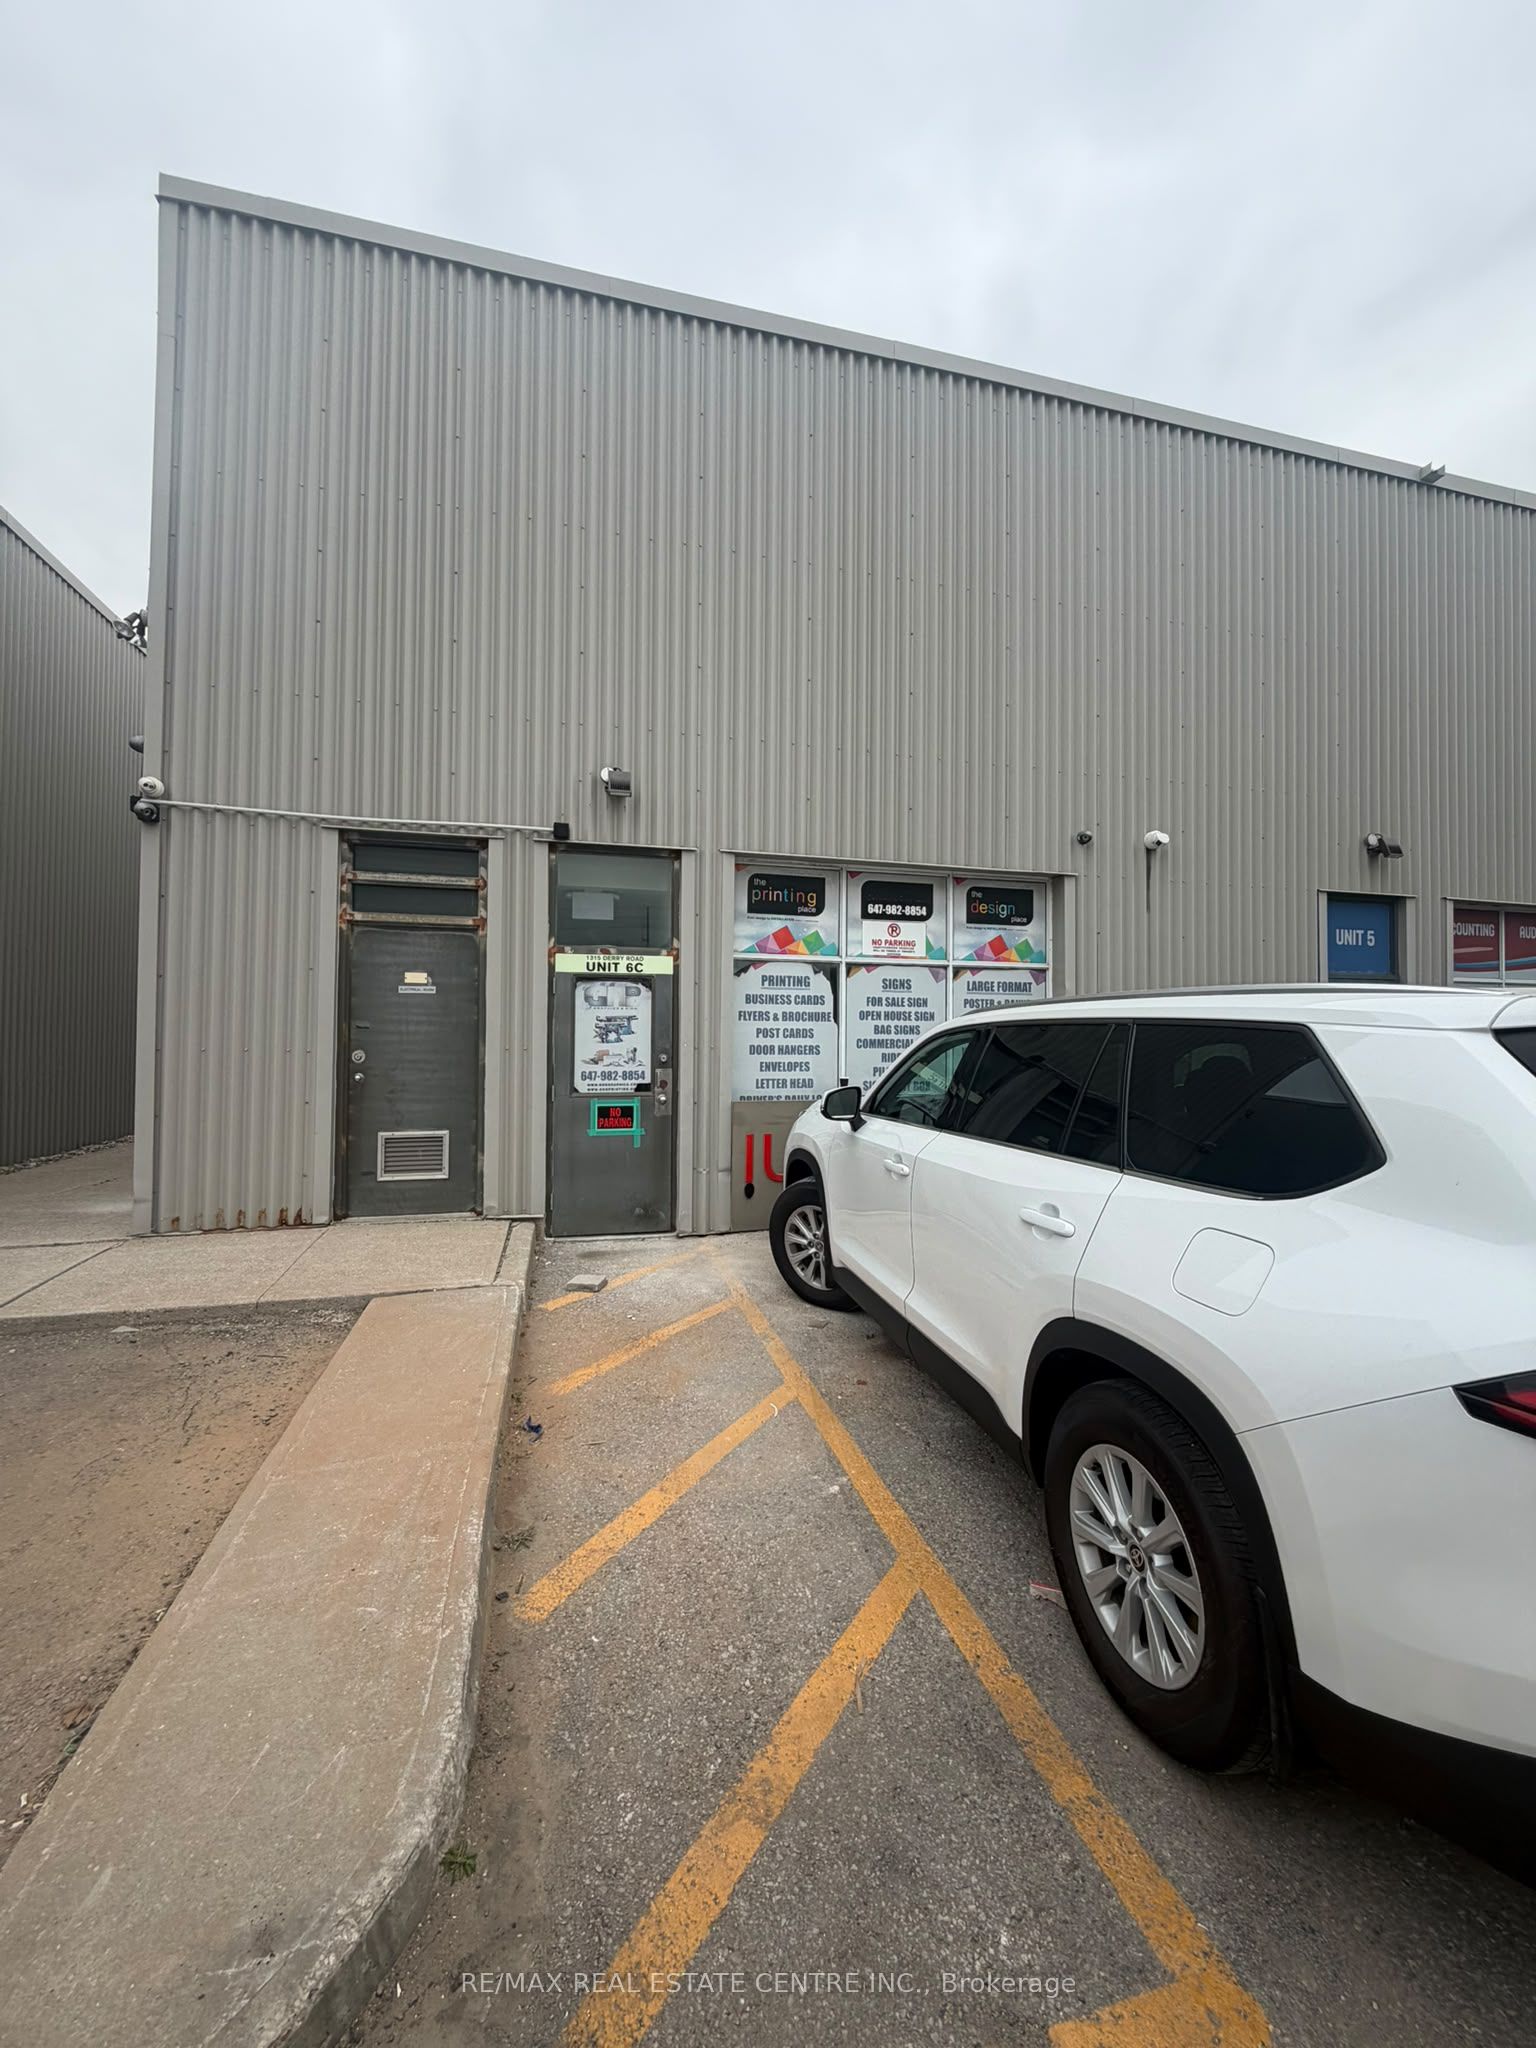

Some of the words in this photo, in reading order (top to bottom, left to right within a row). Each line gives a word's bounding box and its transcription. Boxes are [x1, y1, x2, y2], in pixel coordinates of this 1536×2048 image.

[753, 877, 767, 886] the
[752, 886, 817, 906] printing
[971, 890, 983, 899] the
[797, 905, 817, 914] place
[867, 903, 927, 916] 647-982-8854
[970, 900, 1016, 918] design
[1010, 916, 1028, 924] place
[871, 938, 883, 946] NO
[884, 939, 916, 947] PARKING
[1336, 929, 1364, 946] UNIT
[1367, 930, 1376, 947] 5
[586, 961, 620, 972] UNIT
[625, 962, 644, 973] 6C
[760, 974, 811, 989] PRINTING
[881, 978, 912, 991] SIGNS
[966, 980, 995, 993] LARGE
[996, 981, 1033, 994] FORMAT
[745, 993, 792, 1006] BUSINESS
[793, 994, 826, 1007] CARDS
[866, 996, 883, 1008] FOR
[884, 996, 906, 1008] SALE
[907, 997, 929, 1009] SIGN
[963, 998, 995, 1009] POSTER
[737, 1010, 771, 1022] FLYERS
[772, 1012, 780, 1022] &
[781, 1011, 832, 1023] BROCHURE
[858, 1010, 882, 1021] OPEN
[883, 1010, 913, 1021] HOUSE
[914, 1011, 936, 1022] SIGN
[755, 1027, 781, 1039] POST
[782, 1027, 815, 1039] CARDS
[873, 1024, 893, 1035] BAG
[893, 1024, 921, 1036] SIGNS
[749, 1044, 775, 1056] DOOR
[776, 1044, 822, 1057] HANGERS
[759, 1061, 811, 1073] ENVELOPES
[580, 1070, 646, 1082] 647-982-8854
[755, 1078, 788, 1090] LETTER
[789, 1078, 815, 1090] HEAD
[609, 1107, 622, 1117] NO
[597, 1117, 632, 1128] PARKING
